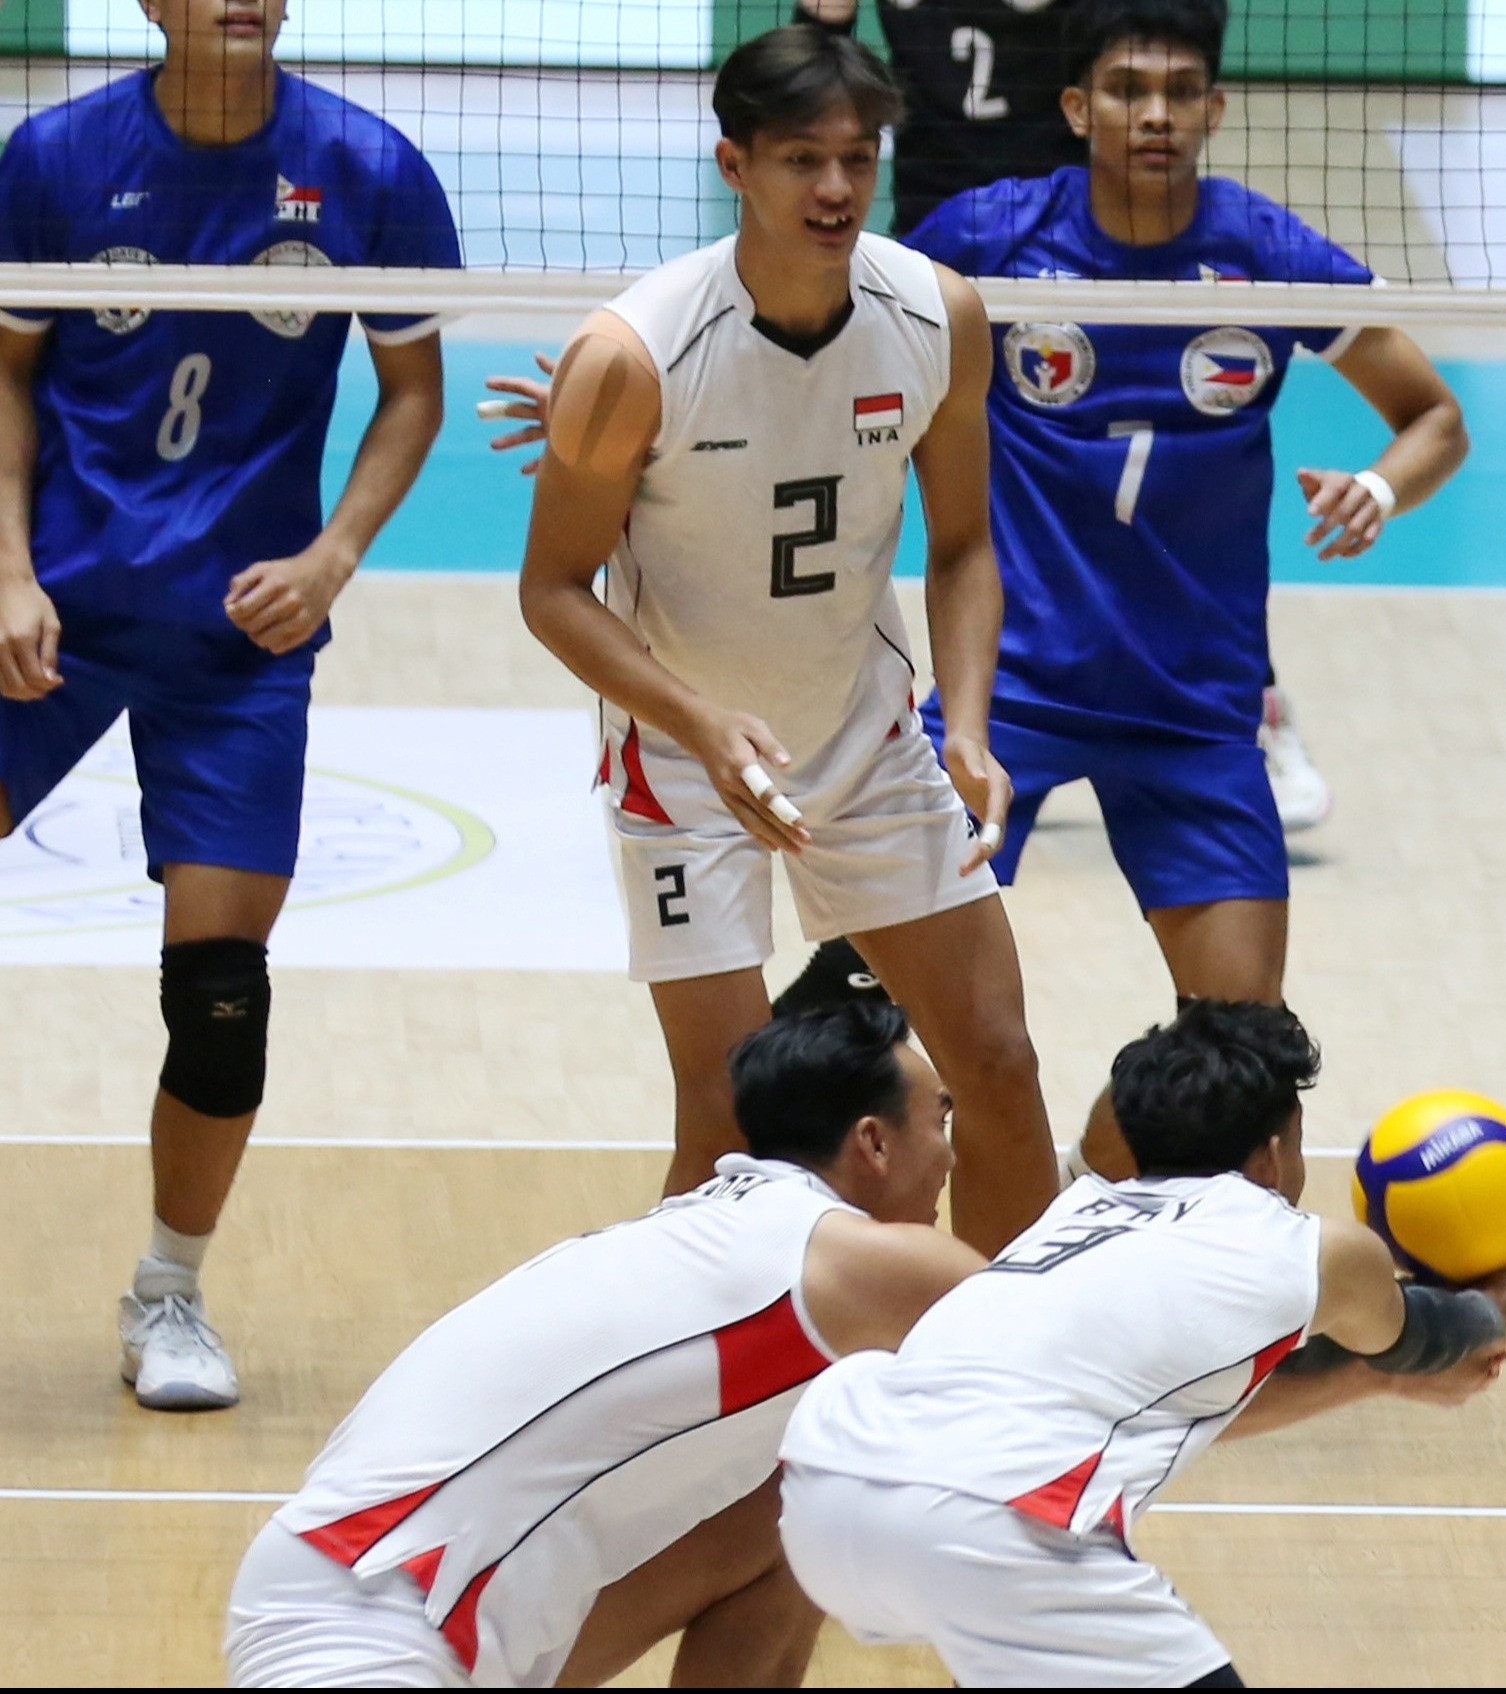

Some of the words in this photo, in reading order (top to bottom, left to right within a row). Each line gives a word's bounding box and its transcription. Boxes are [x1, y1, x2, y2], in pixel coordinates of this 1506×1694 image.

[950, 26, 1009, 120] 2
[156, 352, 212, 461] 8
[857, 429, 899, 446] INA
[1106, 420, 1154, 526] 7
[770, 475, 845, 598] 2
[654, 863, 690, 927] 2
[983, 1224, 1140, 1275] 3
